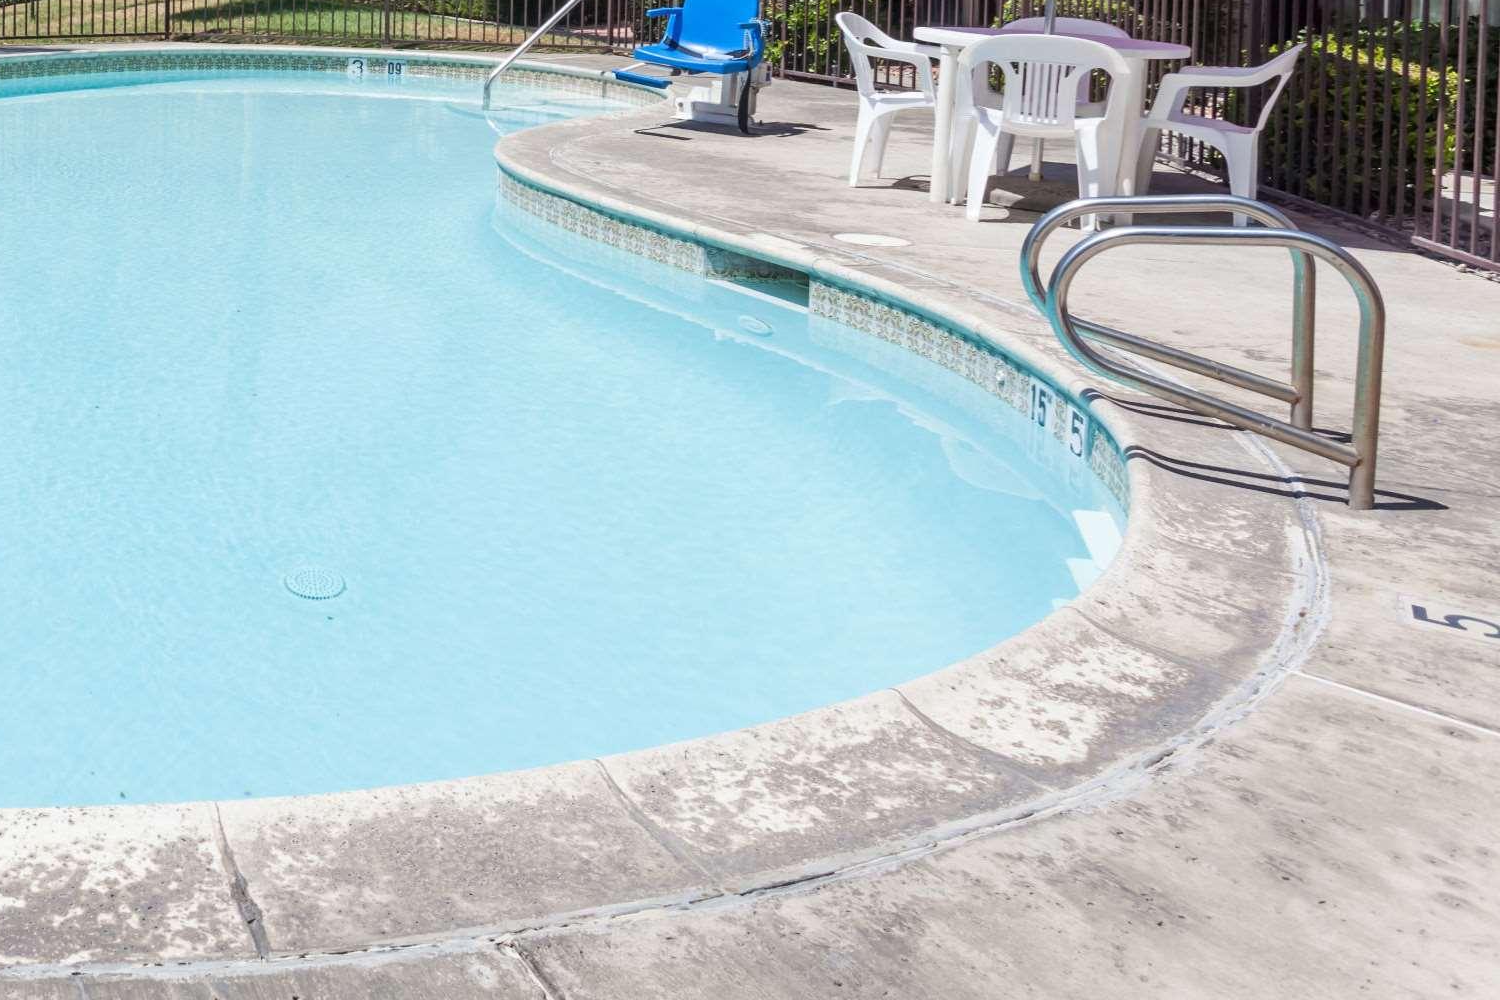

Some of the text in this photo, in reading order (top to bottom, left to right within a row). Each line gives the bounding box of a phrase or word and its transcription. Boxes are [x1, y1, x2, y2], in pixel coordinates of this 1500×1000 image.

[388, 62, 402, 74] 09
[1070, 411, 1084, 457] 5
[1411, 604, 1500, 639] 5
